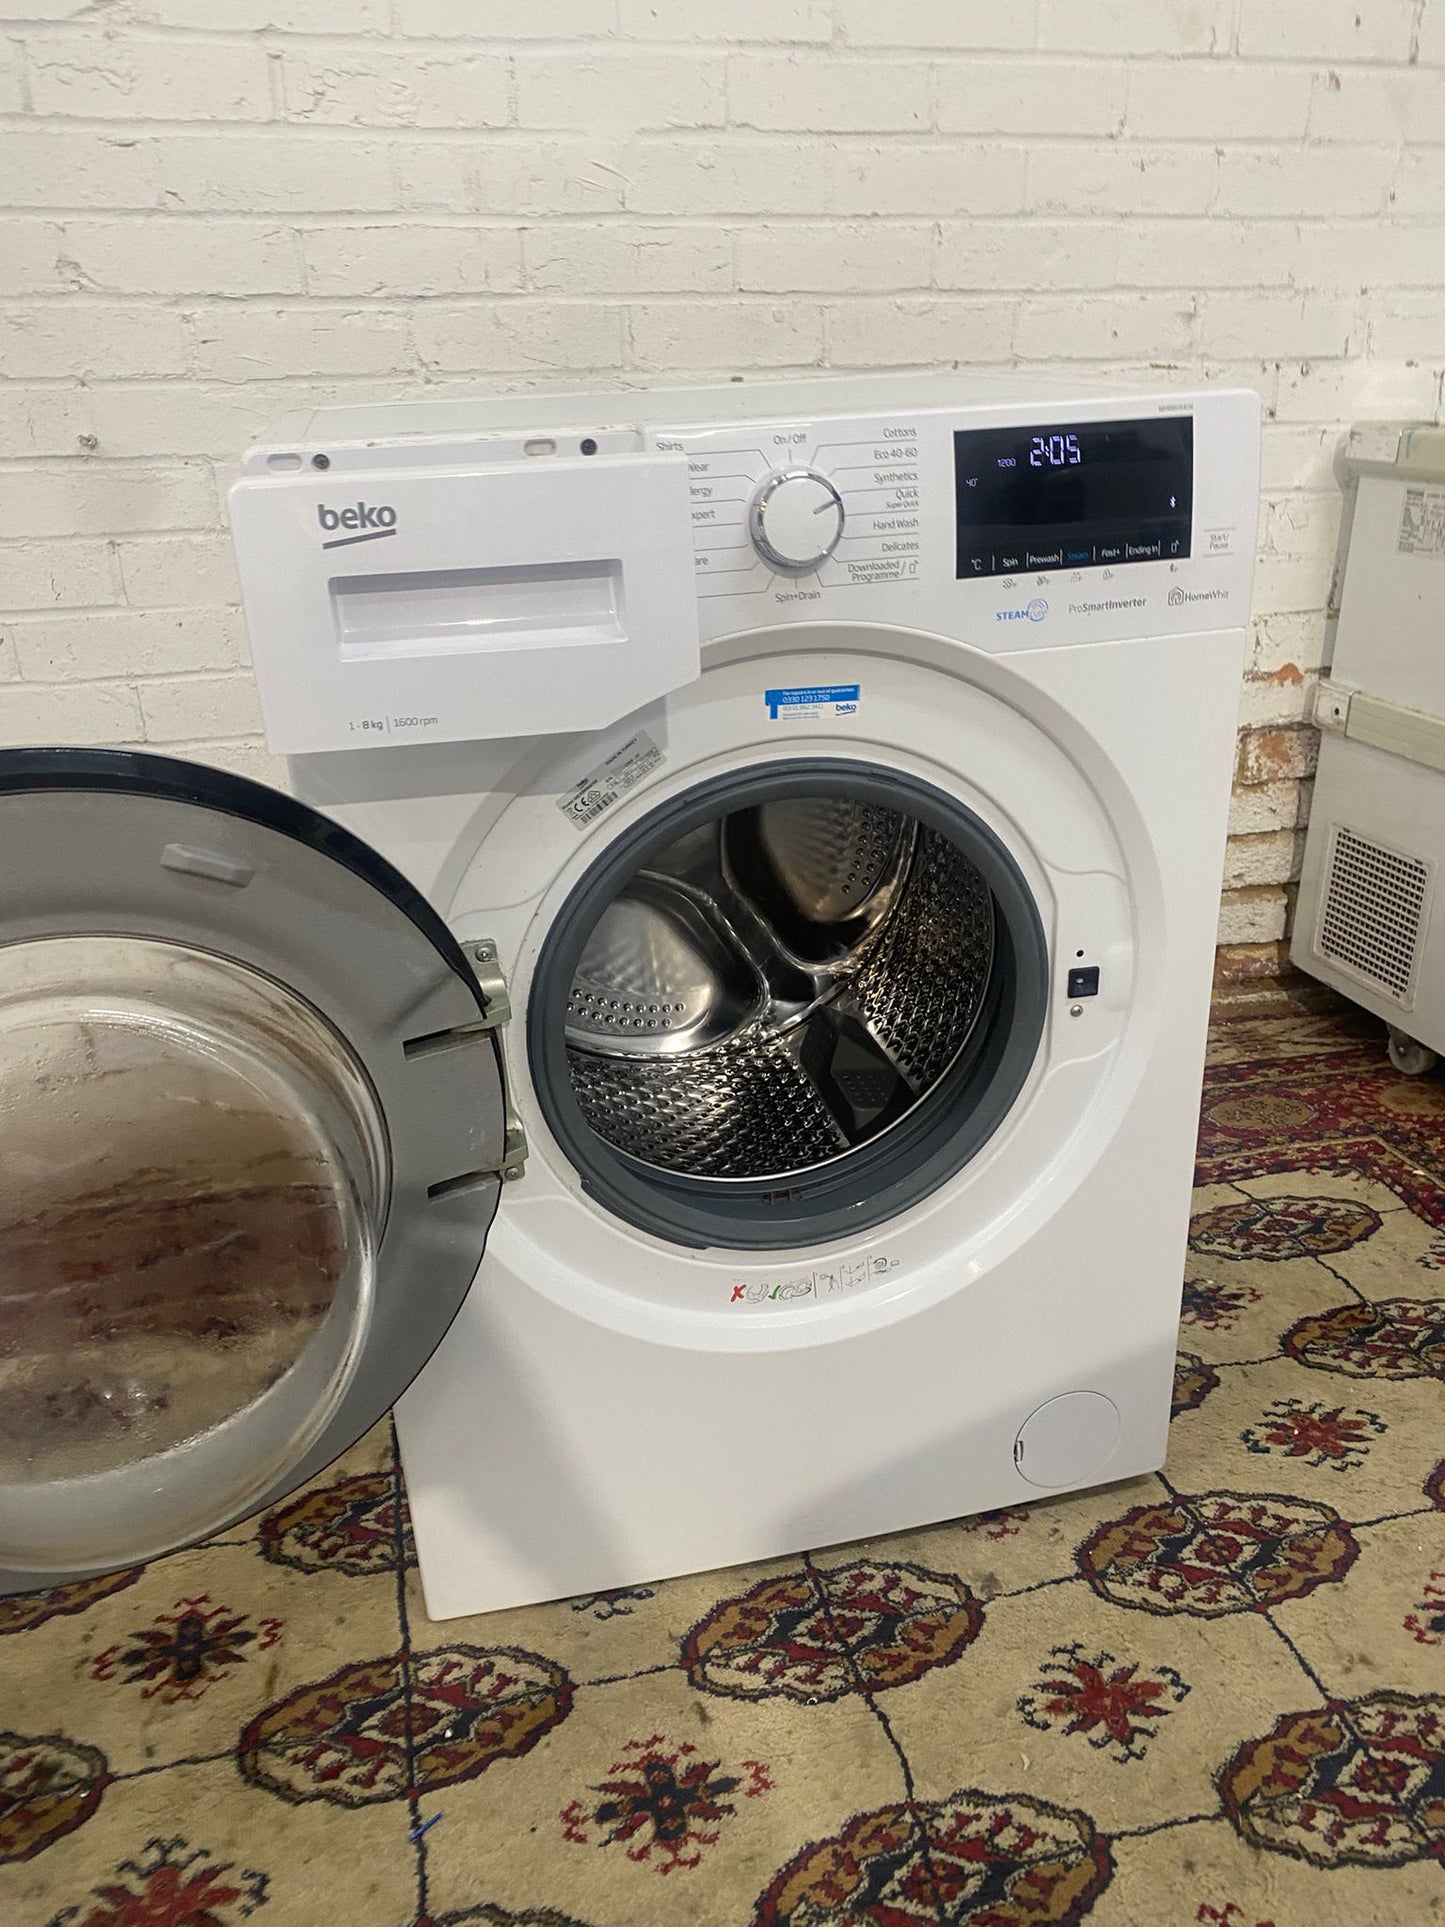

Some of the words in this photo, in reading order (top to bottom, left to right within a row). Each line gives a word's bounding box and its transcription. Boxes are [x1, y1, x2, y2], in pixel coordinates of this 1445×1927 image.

[883, 427, 917, 438] Cottons
[873, 449, 889, 460] Eco
[1030, 434, 1080, 466] 2:05
[997, 458, 1017, 468] 1200
[873, 471, 918, 484] Synthetics
[896, 487, 919, 500] Quick
[317, 501, 397, 531] beko
[873, 519, 896, 530] Hand
[896, 517, 919, 528] Wash
[881, 542, 920, 552] Delicates
[1128, 545, 1151, 557] Ending
[1002, 558, 1019, 568] Spin
[1029, 553, 1060, 565] Prewash
[847, 560, 900, 573] Downloaded
[852, 570, 899, 583] Programme
[775, 590, 821, 603] Spin+Drain
[1184, 588, 1229, 602] HomeWhiz
[1068, 598, 1146, 614] ProSmartInverter
[995, 609, 1029, 621] STEAM
[783, 694, 800, 703] 0330
[801, 694, 813, 702] 123
[835, 703, 857, 712] beko
[371, 719, 383, 731] kg
[393, 717, 419, 728] 1600
[419, 717, 438, 727] rpm
